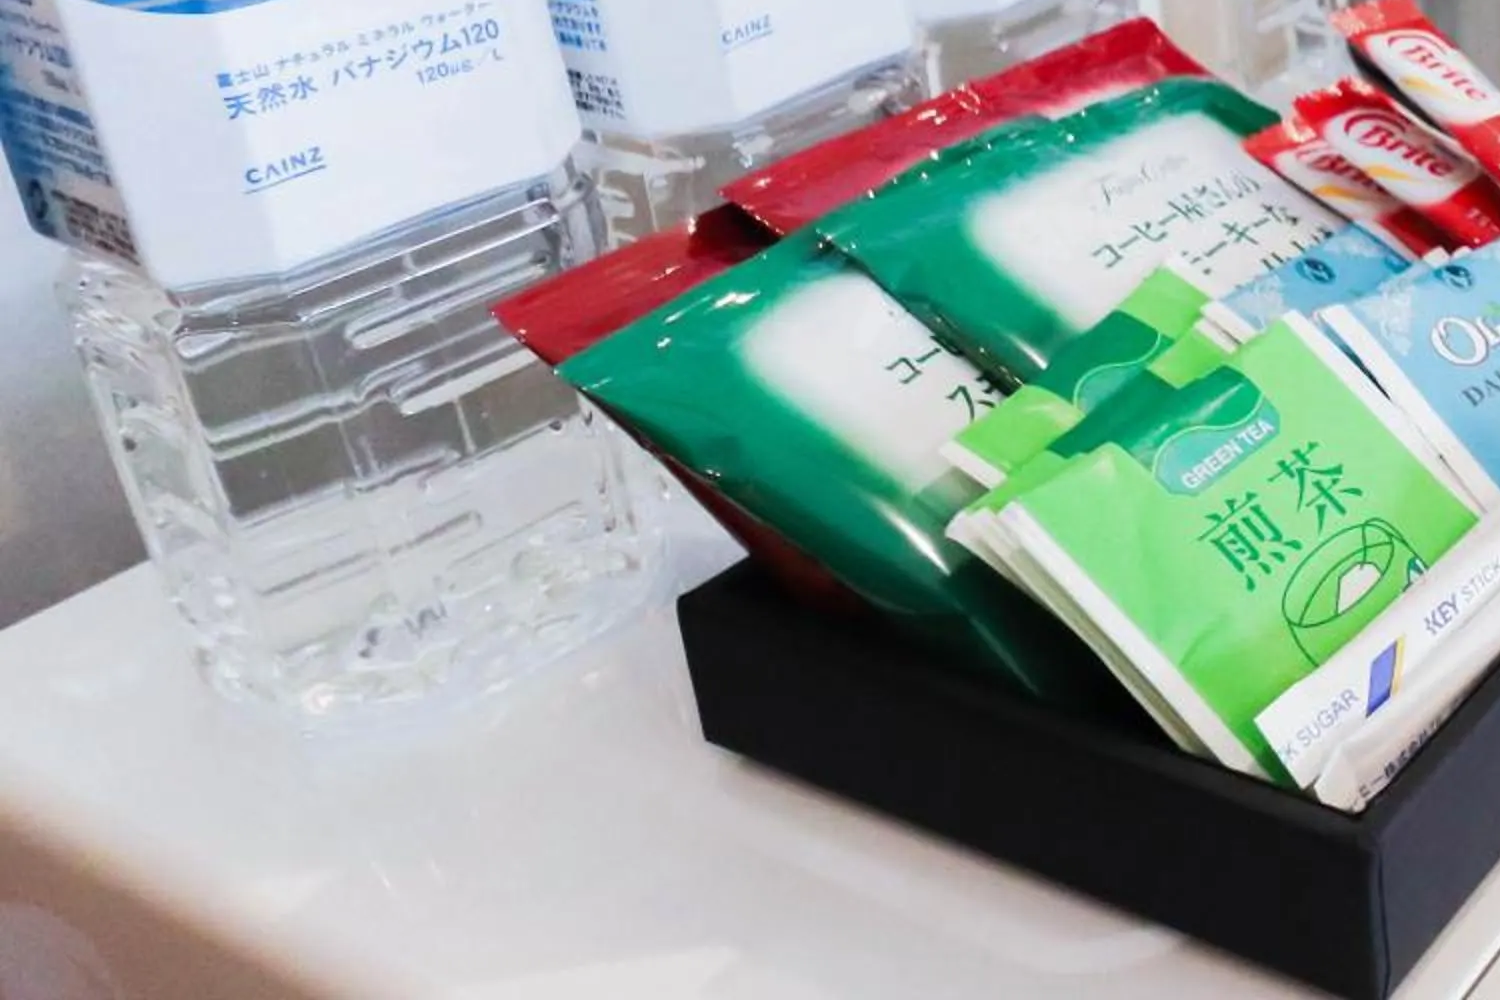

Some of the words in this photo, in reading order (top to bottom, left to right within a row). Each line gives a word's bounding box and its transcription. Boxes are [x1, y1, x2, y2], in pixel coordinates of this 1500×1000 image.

[223, 75, 318, 120] 天然水
[332, 18, 500, 86] バナジウム120
[1400, 45, 1488, 100] Brite
[245, 146, 324, 185] CAINZ
[1358, 124, 1454, 177] Brite
[1181, 438, 1244, 488] GREEN
[1236, 419, 1275, 446] TEA
[1197, 441, 1363, 592] 煎茶
[1424, 593, 1459, 635] KEY
[1297, 689, 1359, 748] SUGAR
